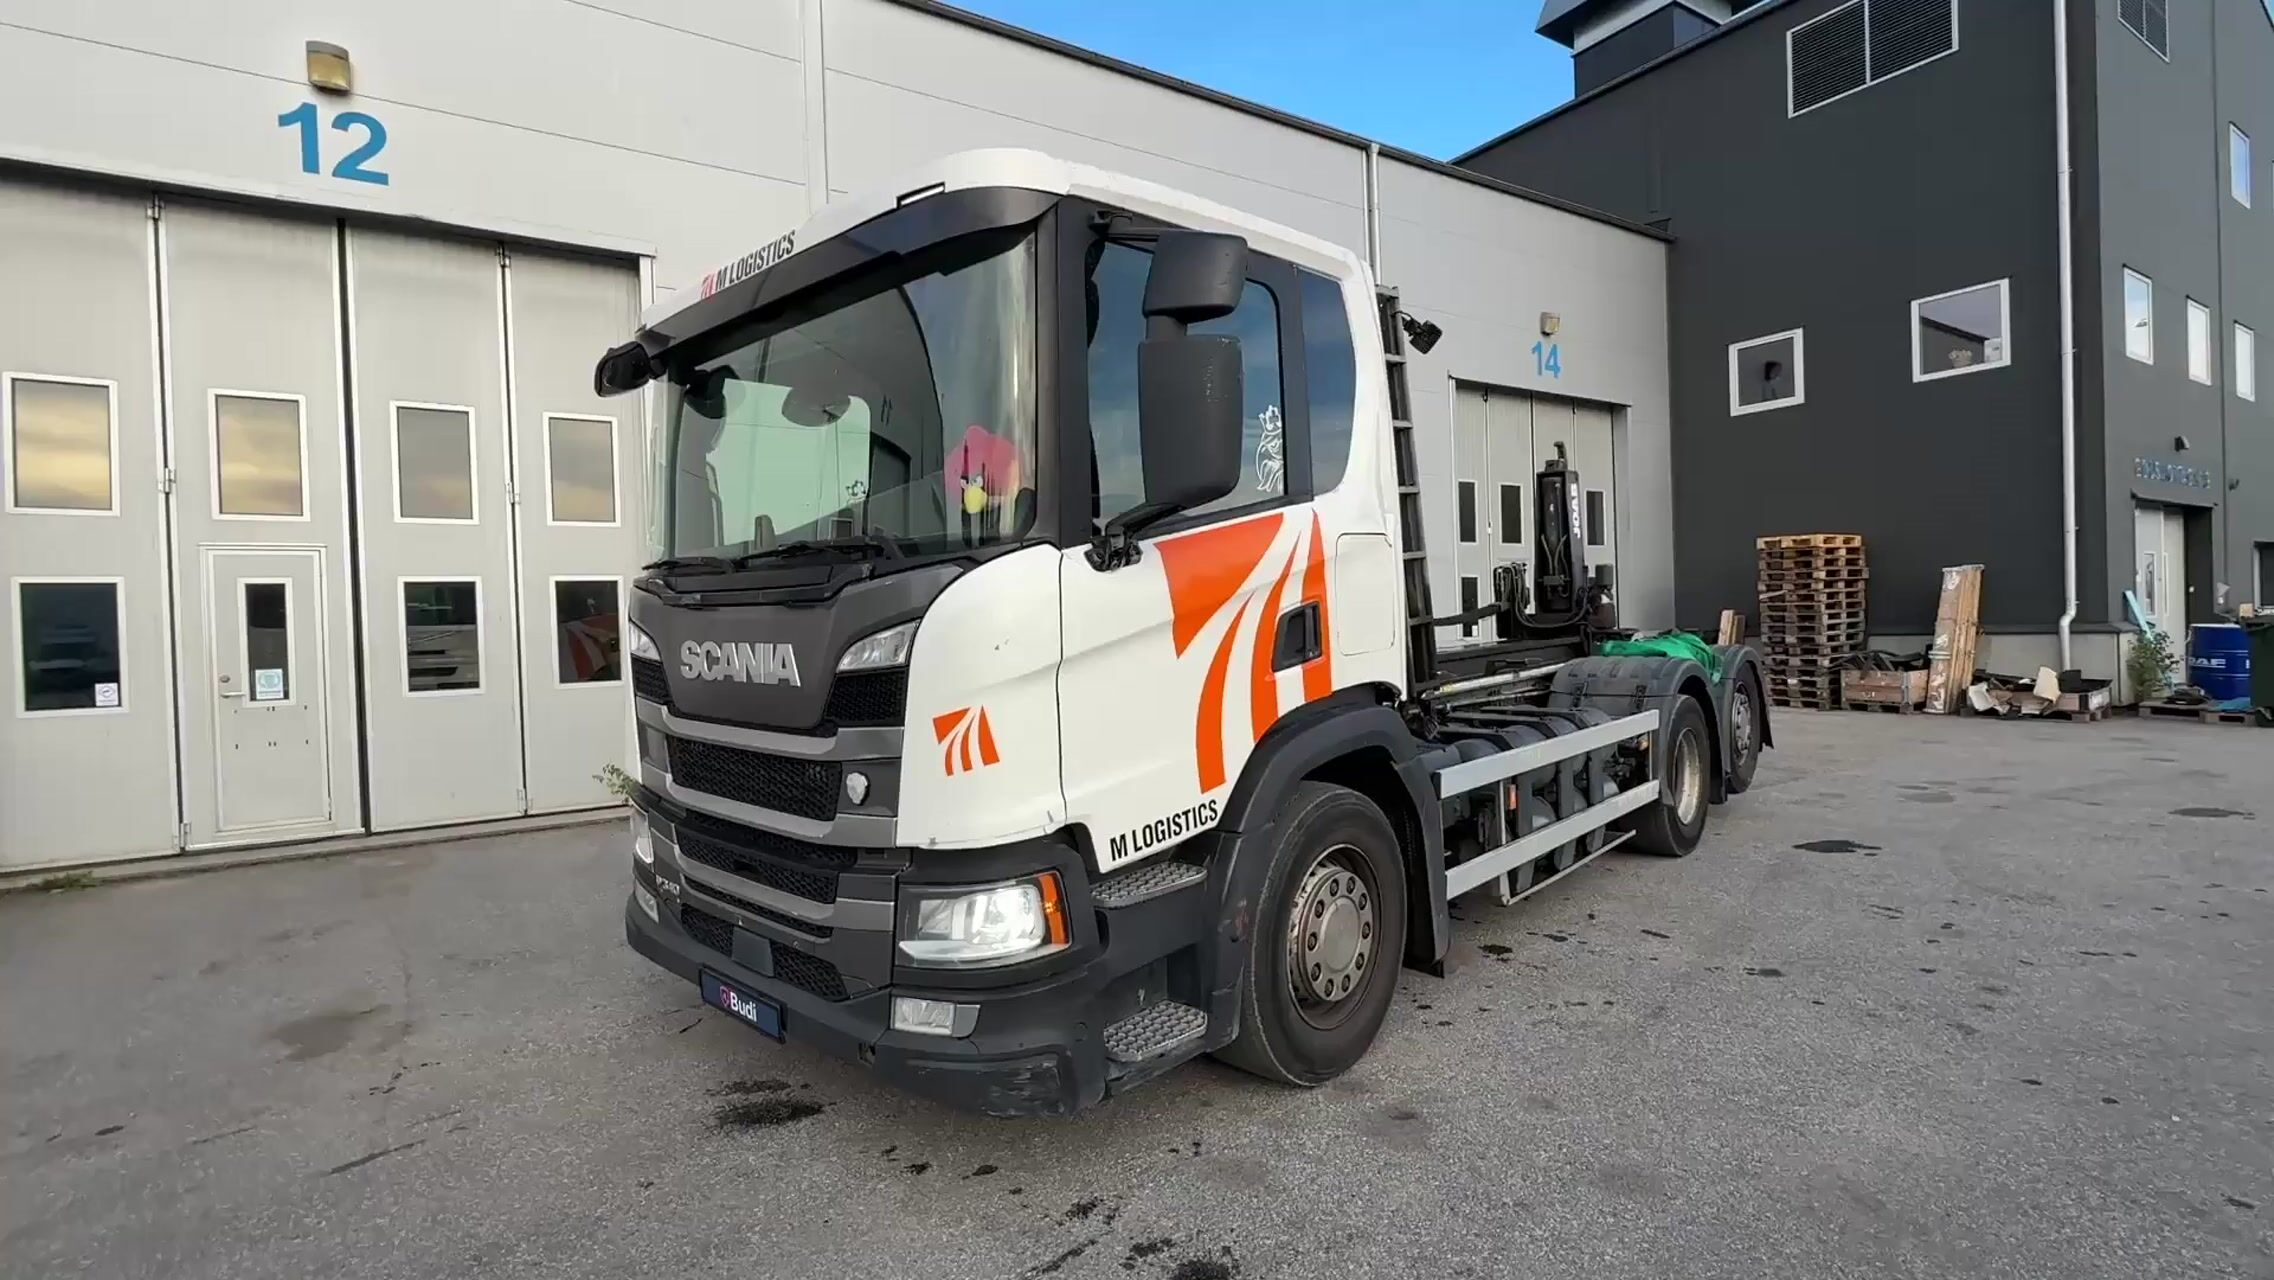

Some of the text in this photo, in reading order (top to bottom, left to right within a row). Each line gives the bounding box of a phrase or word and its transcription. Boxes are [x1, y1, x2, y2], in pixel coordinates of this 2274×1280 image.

[278, 101, 389, 186] 12
[715, 229, 796, 292] M LOGISTICS
[1531, 340, 1561, 379] 14
[680, 639, 801, 688] SCANIA
[1109, 799, 1219, 862] M LOGISTICS
[730, 991, 758, 1022] Budi
